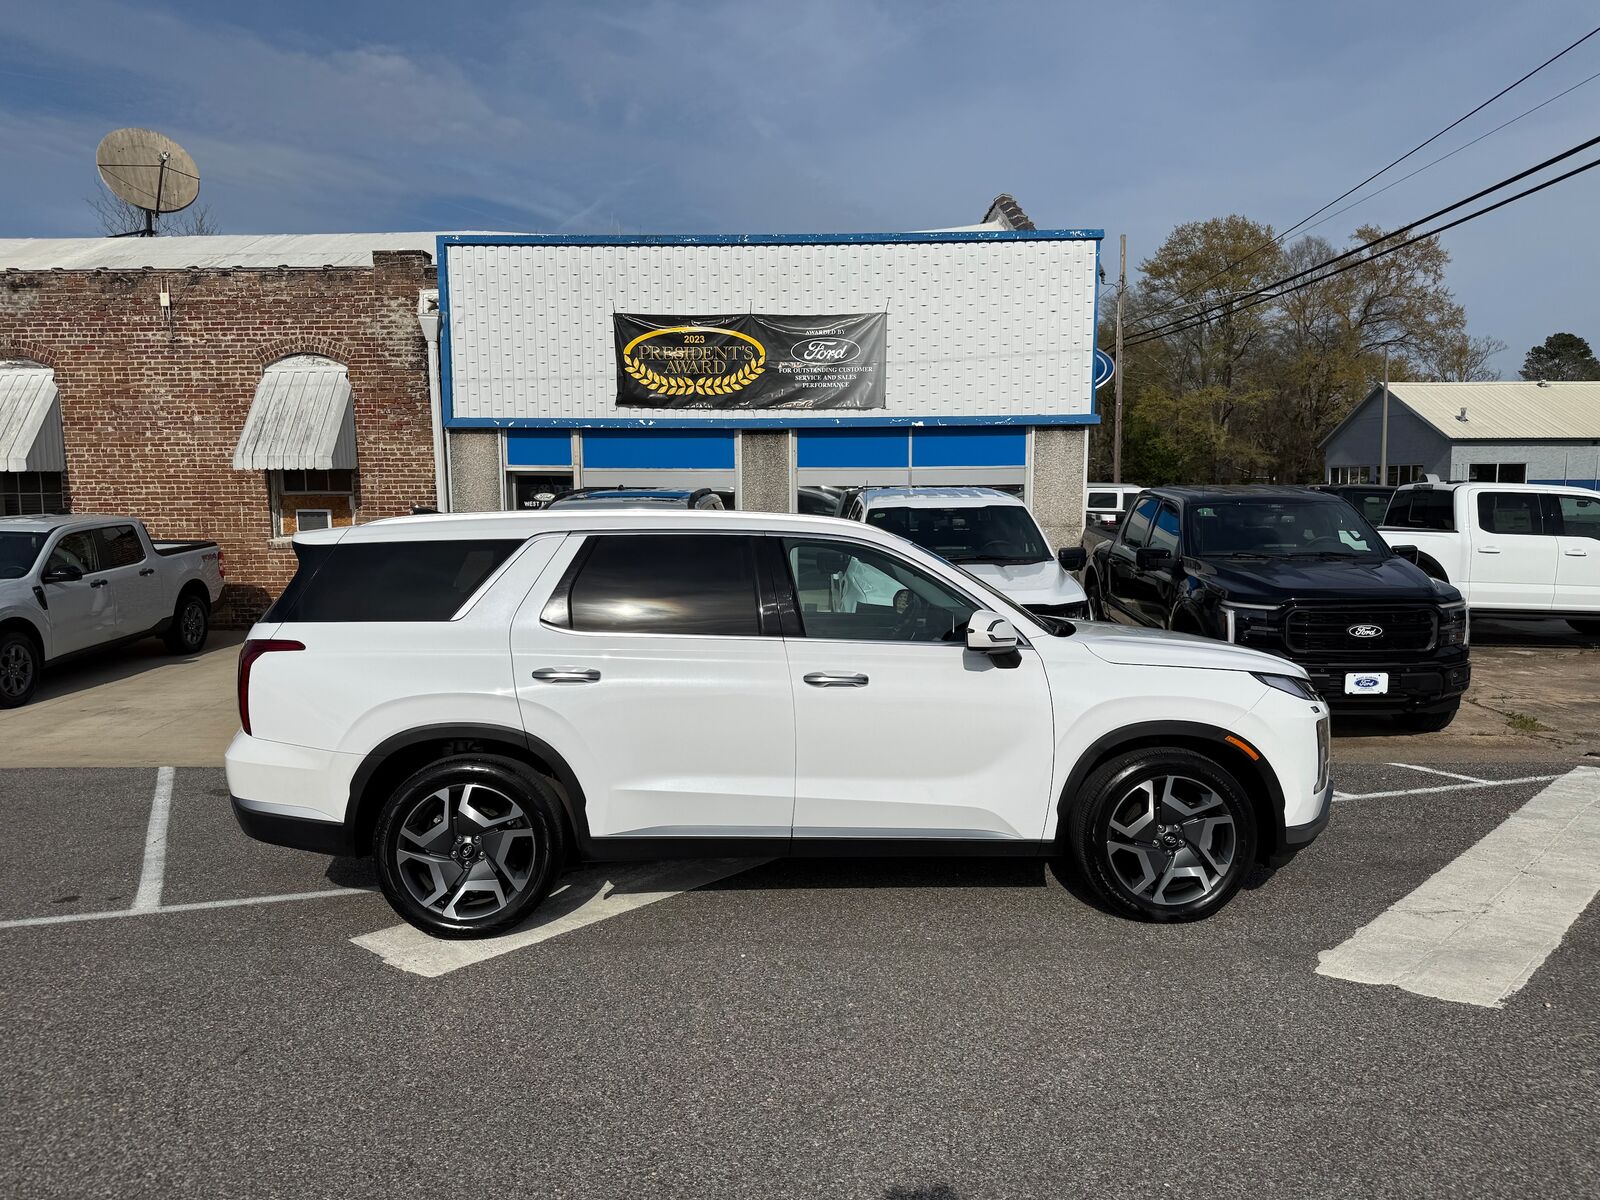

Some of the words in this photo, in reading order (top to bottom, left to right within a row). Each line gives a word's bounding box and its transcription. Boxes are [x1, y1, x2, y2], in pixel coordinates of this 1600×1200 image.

[683, 335, 705, 344] 2023
[638, 345, 754, 361] PRESIDENT'S
[803, 341, 848, 360] Ford
[664, 360, 727, 374] AWARD
[1355, 626, 1377, 635] Ford
[1359, 679, 1375, 687] Ford
